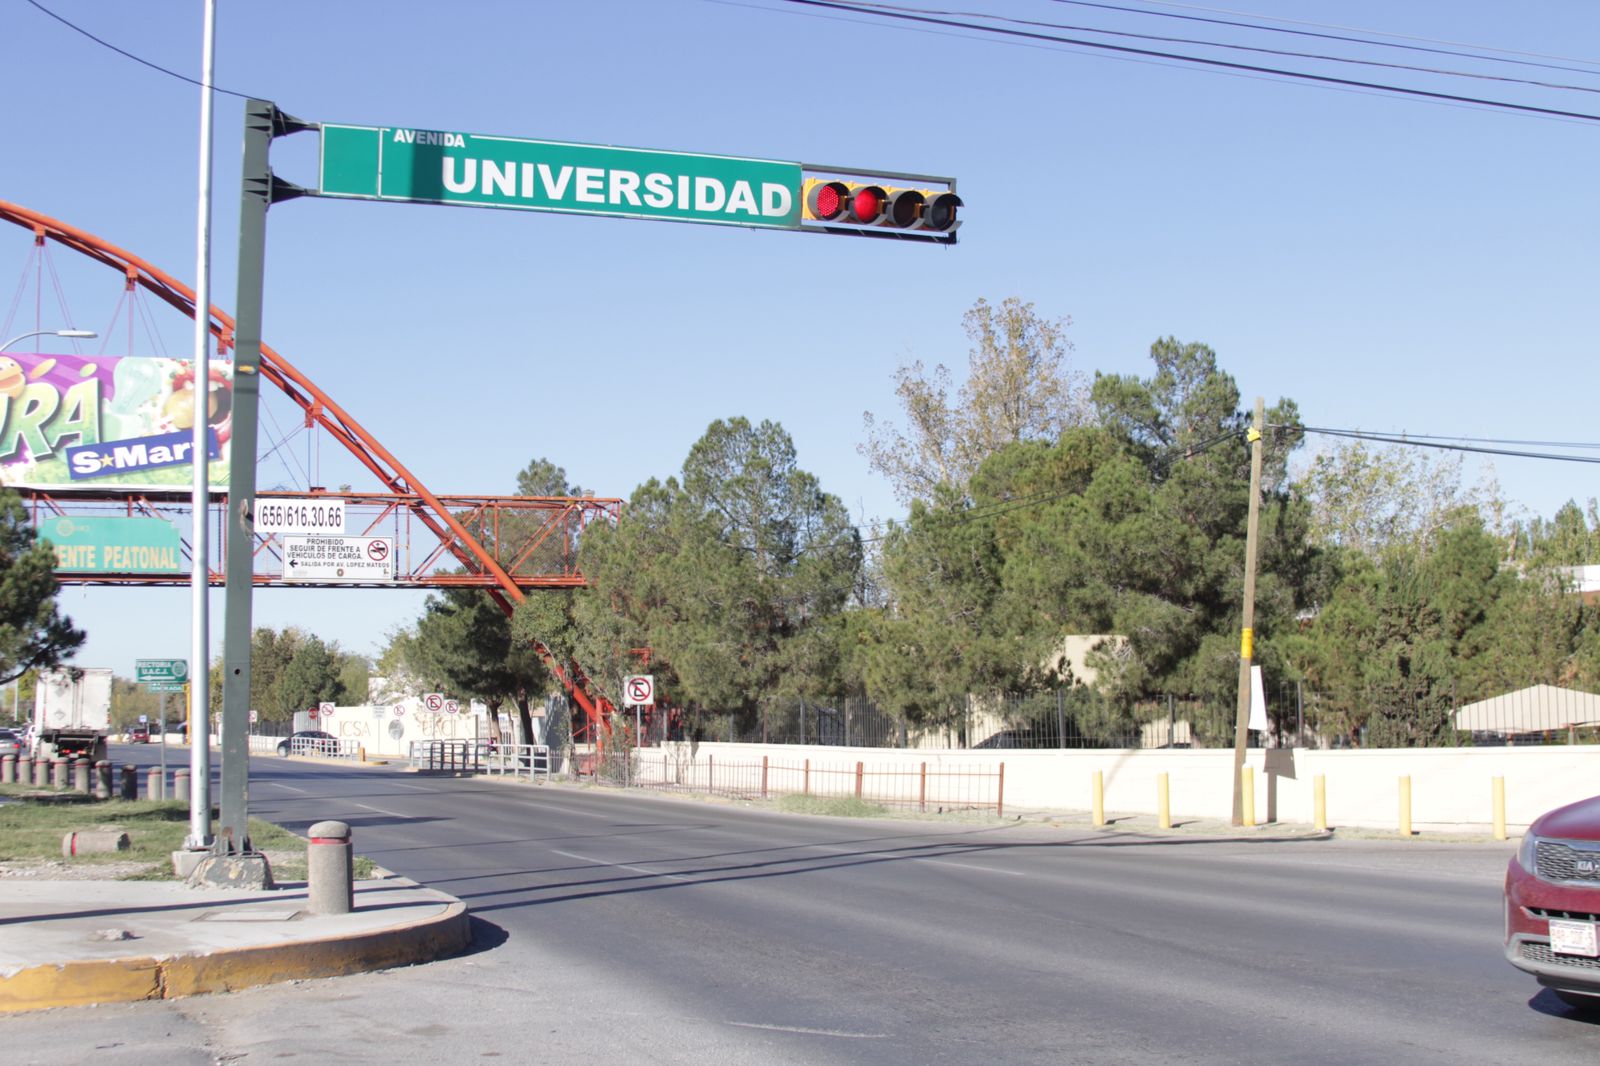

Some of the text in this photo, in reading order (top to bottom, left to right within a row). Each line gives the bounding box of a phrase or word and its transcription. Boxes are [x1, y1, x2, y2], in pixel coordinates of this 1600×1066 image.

[393, 128, 466, 149] AVENIDA
[441, 155, 793, 218] UNIVERSIDAD
[113, 441, 204, 469] Mar
[258, 504, 342, 528] (656)616.30.66
[306, 538, 344, 546] PROHIBIDO
[53, 545, 178, 569] ENTE PEATONAL
[339, 720, 371, 737] ICSA
[1577, 861, 1594, 871] KIA
